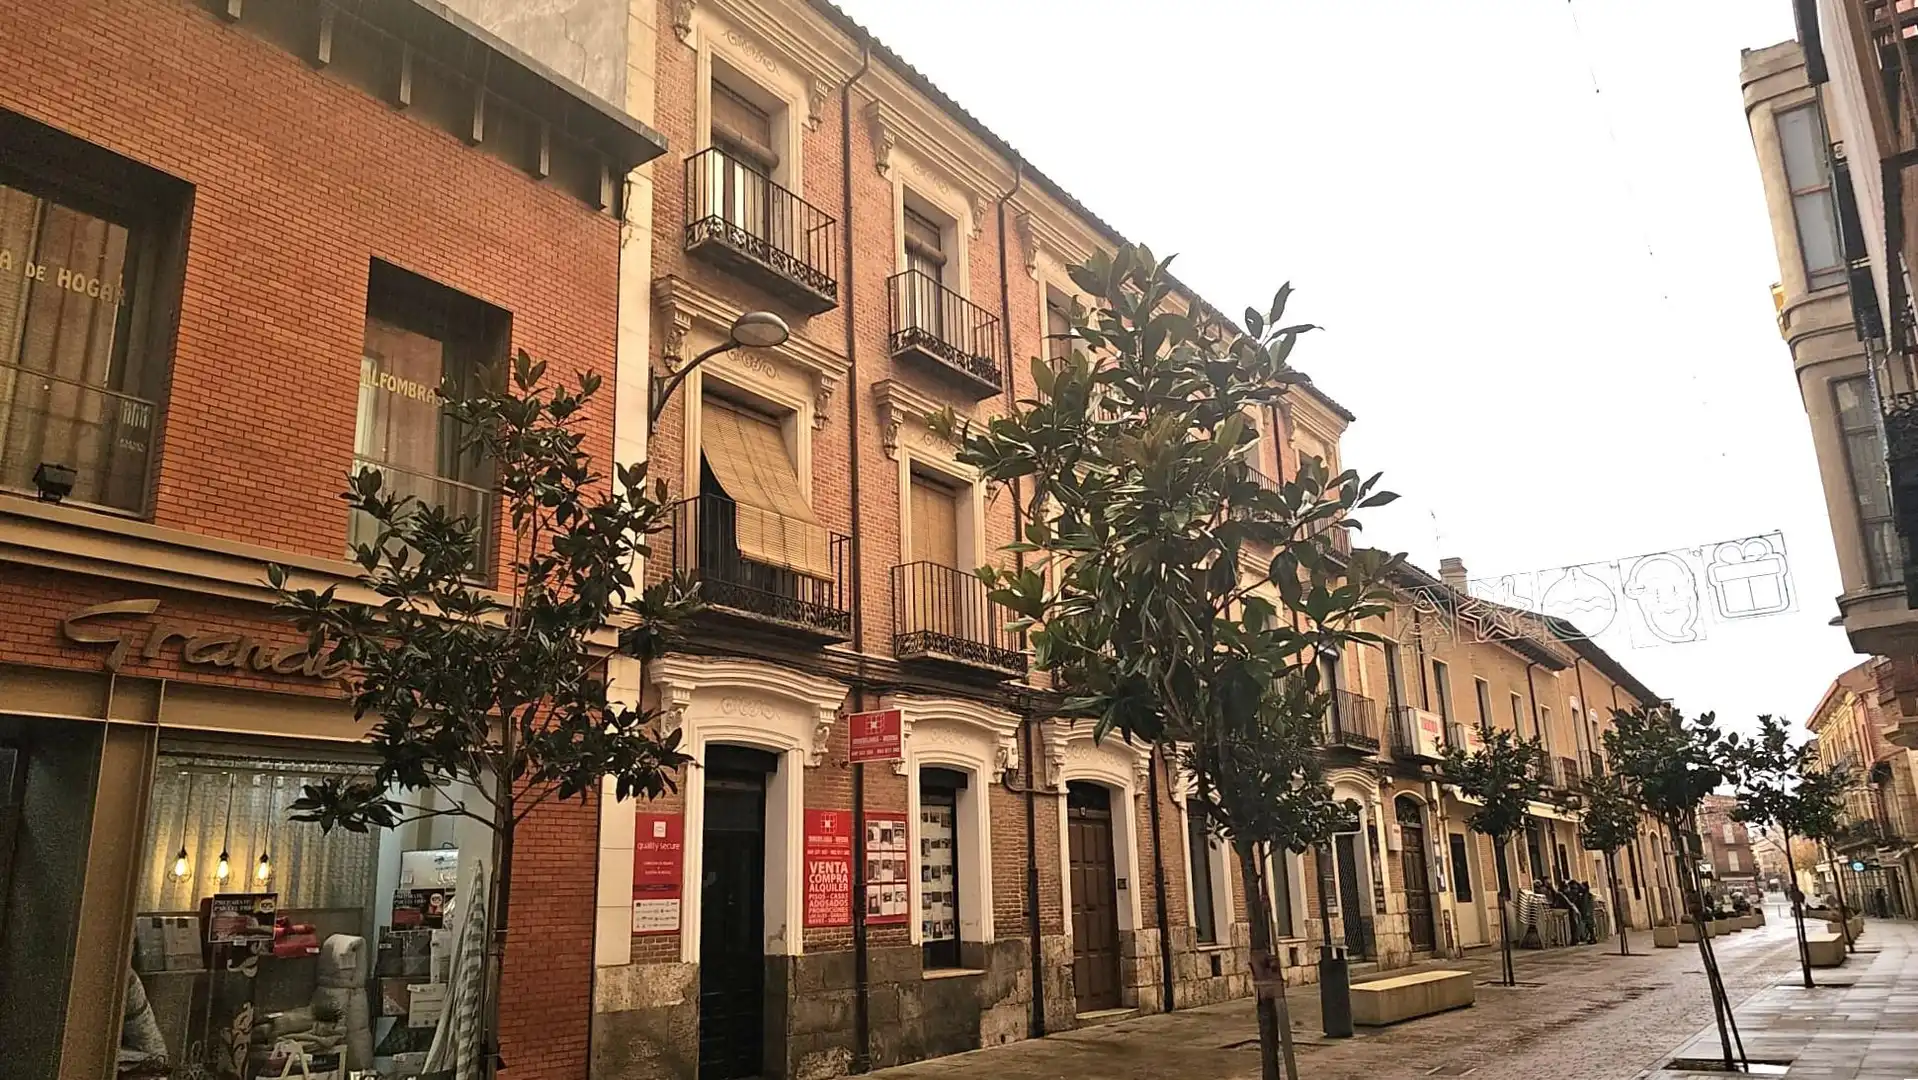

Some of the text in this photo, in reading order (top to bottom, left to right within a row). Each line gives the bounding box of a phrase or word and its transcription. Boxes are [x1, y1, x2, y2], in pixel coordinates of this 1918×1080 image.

[25, 261, 47, 282] DE
[57, 267, 125, 306] HOGAR
[809, 862, 849, 874] VENTA
[809, 874, 849, 884] COMPRA
[809, 883, 849, 895] ALQUILER
[809, 899, 849, 908] ADOSADOS
